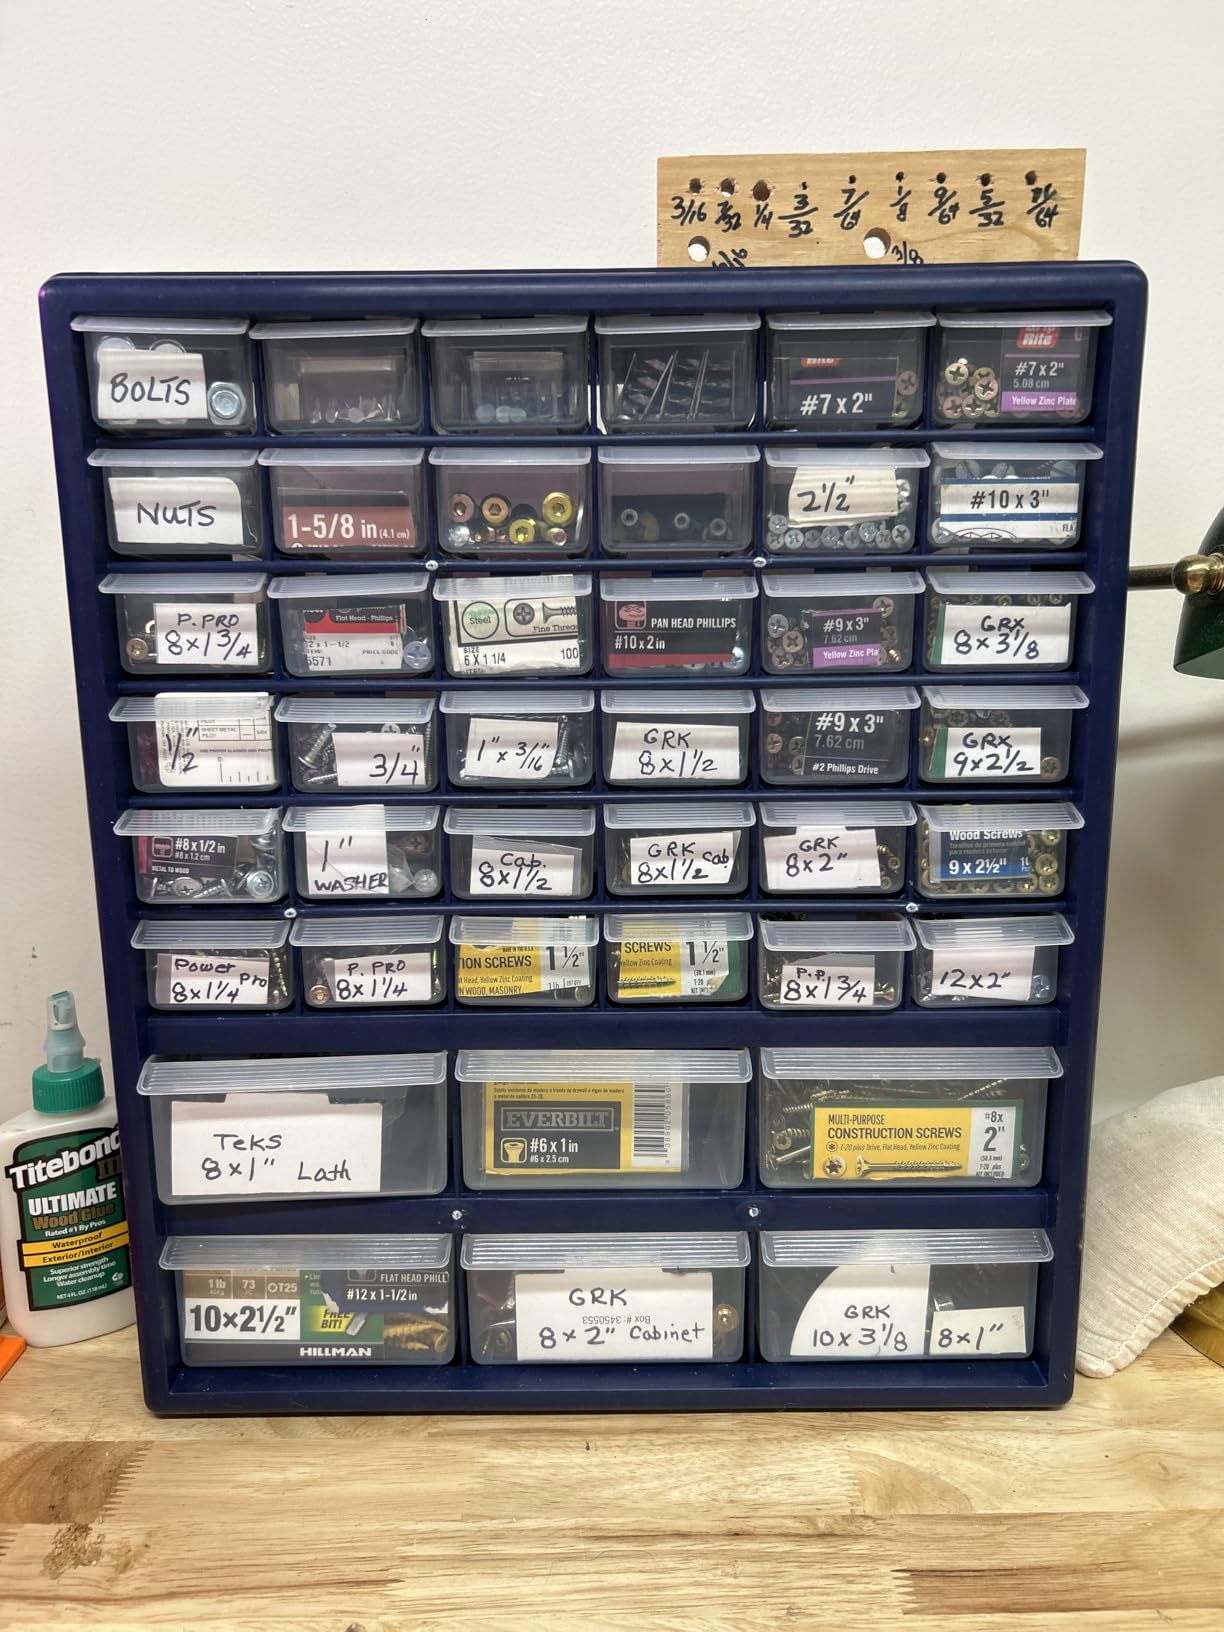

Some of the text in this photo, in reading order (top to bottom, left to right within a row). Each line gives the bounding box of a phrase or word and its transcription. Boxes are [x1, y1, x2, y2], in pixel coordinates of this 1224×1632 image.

[671, 196, 707, 226] 3/16
[754, 203, 773, 230] 1/4
[778, 194, 818, 238] 3/32
[833, 188, 869, 230] 7/64
[890, 185, 912, 222] 1/8
[927, 186, 960, 225] 9/64
[968, 188, 1005, 228] 5/32
[1015, 361, 1065, 376] #7 x 2"
[110, 372, 191, 405] BOLTS
[1013, 378, 1050, 389] 5.08 cm
[800, 391, 873, 415] #7 x 2"
[970, 489, 1050, 510] #10 x 3"
[137, 500, 217, 528] NUTS
[288, 513, 411, 540] 1-5/8 in (4.1 cm)
[469, 616, 492, 625] Steel
[650, 617, 737, 630] PAN HEAD PHILLIPS
[823, 617, 870, 632] #9 x 3"
[823, 633, 858, 644] 7.62 cm
[560, 647, 579, 660] 100
[815, 712, 884, 734] #9 x 3"
[643, 728, 692, 749] GRK
[814, 734, 865, 750] 7.62 cm
[812, 762, 879, 775] #2 Phillips Drive
[949, 828, 1024, 841] Wood Screws
[175, 838, 226, 854] #8 x 1/2 in
[648, 841, 696, 858] GRK
[799, 836, 841, 853] GRK
[321, 835, 353, 873] 1"
[314, 872, 389, 892] WASHER
[624, 941, 672, 953] SCREWS
[174, 958, 237, 974] Power
[239, 973, 268, 987] Pro
[505, 1110, 610, 1128] EVERBILT
[828, 1113, 886, 1126] MULTI-PURPOSE
[984, 1110, 1004, 1123] #8x
[827, 1126, 962, 1140] CONSTRUCTION SCREWS
[983, 1126, 1005, 1152] 2"
[529, 1137, 579, 1153] #6 x 1 in
[529, 1154, 539, 1163] #6
[545, 1154, 557, 1163] 2.5
[297, 1159, 353, 1182] Lath
[28, 1181, 118, 1216] ULTIMATE
[31, 1204, 115, 1230] Wood Glue
[44, 1219, 107, 1238] Rated #1 By Pros
[52, 1232, 104, 1250] Waterproof
[42, 1241, 115, 1263] Exterior/Interior
[43, 1260, 117, 1283] Longer assembly time
[49, 1256, 109, 1276] Superior strength
[56, 1271, 106, 1287] Water cleanup
[241, 1279, 256, 1290] 73
[380, 1272, 449, 1283] FLAT HEAD PHILL
[278, 1282, 298, 1293] T25
[346, 1288, 418, 1301] #12 x 1-1/2 in
[568, 1287, 628, 1307] GRK
[844, 1304, 891, 1320] GRK
[320, 1319, 343, 1329] BIT!
[629, 1321, 706, 1344] Cabinet
[300, 1347, 372, 1357] HILLMAN
